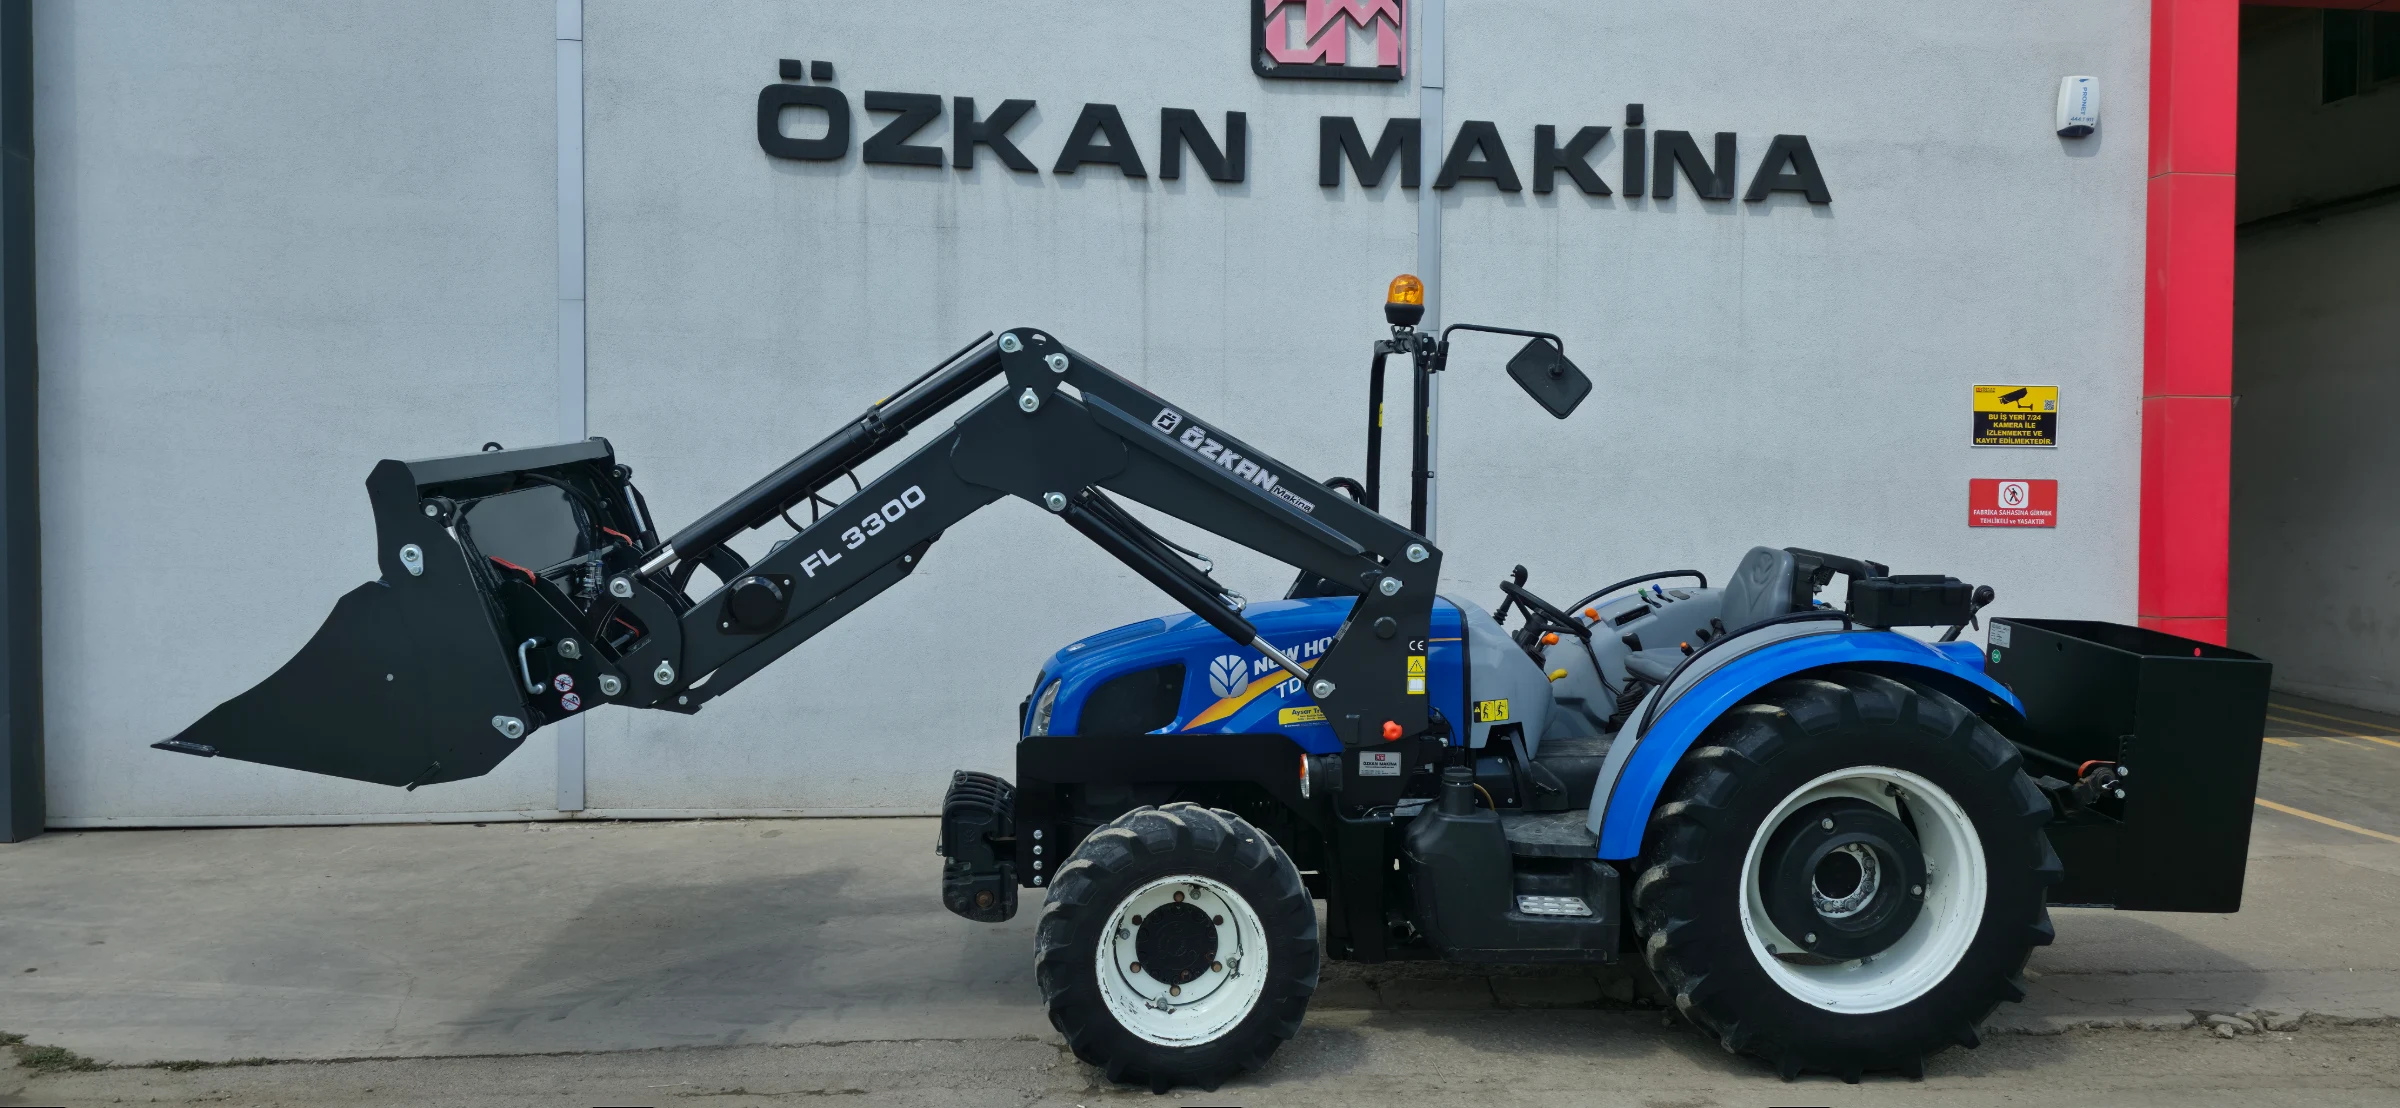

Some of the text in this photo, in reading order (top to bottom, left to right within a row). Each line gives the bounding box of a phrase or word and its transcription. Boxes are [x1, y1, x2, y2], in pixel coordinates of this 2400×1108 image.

[757, 58, 1832, 204] ÖZKAN MAKİNA
[2000, 413, 2007, 421] İŞ
[2008, 413, 2025, 421] YERİ
[2024, 421, 2036, 429] İLE
[1986, 429, 2032, 437] İZLENMEKTE
[1998, 437, 2053, 445] EDİLMEKTEDİR.
[1179, 425, 1280, 492] ÖZKAN
[1273, 485, 1312, 512] Makina
[2029, 509, 2052, 517] GİRMEK
[800, 484, 926, 578] FL 3300
[1304, 636, 1335, 658] HO
[1408, 640, 1424, 651] CE
